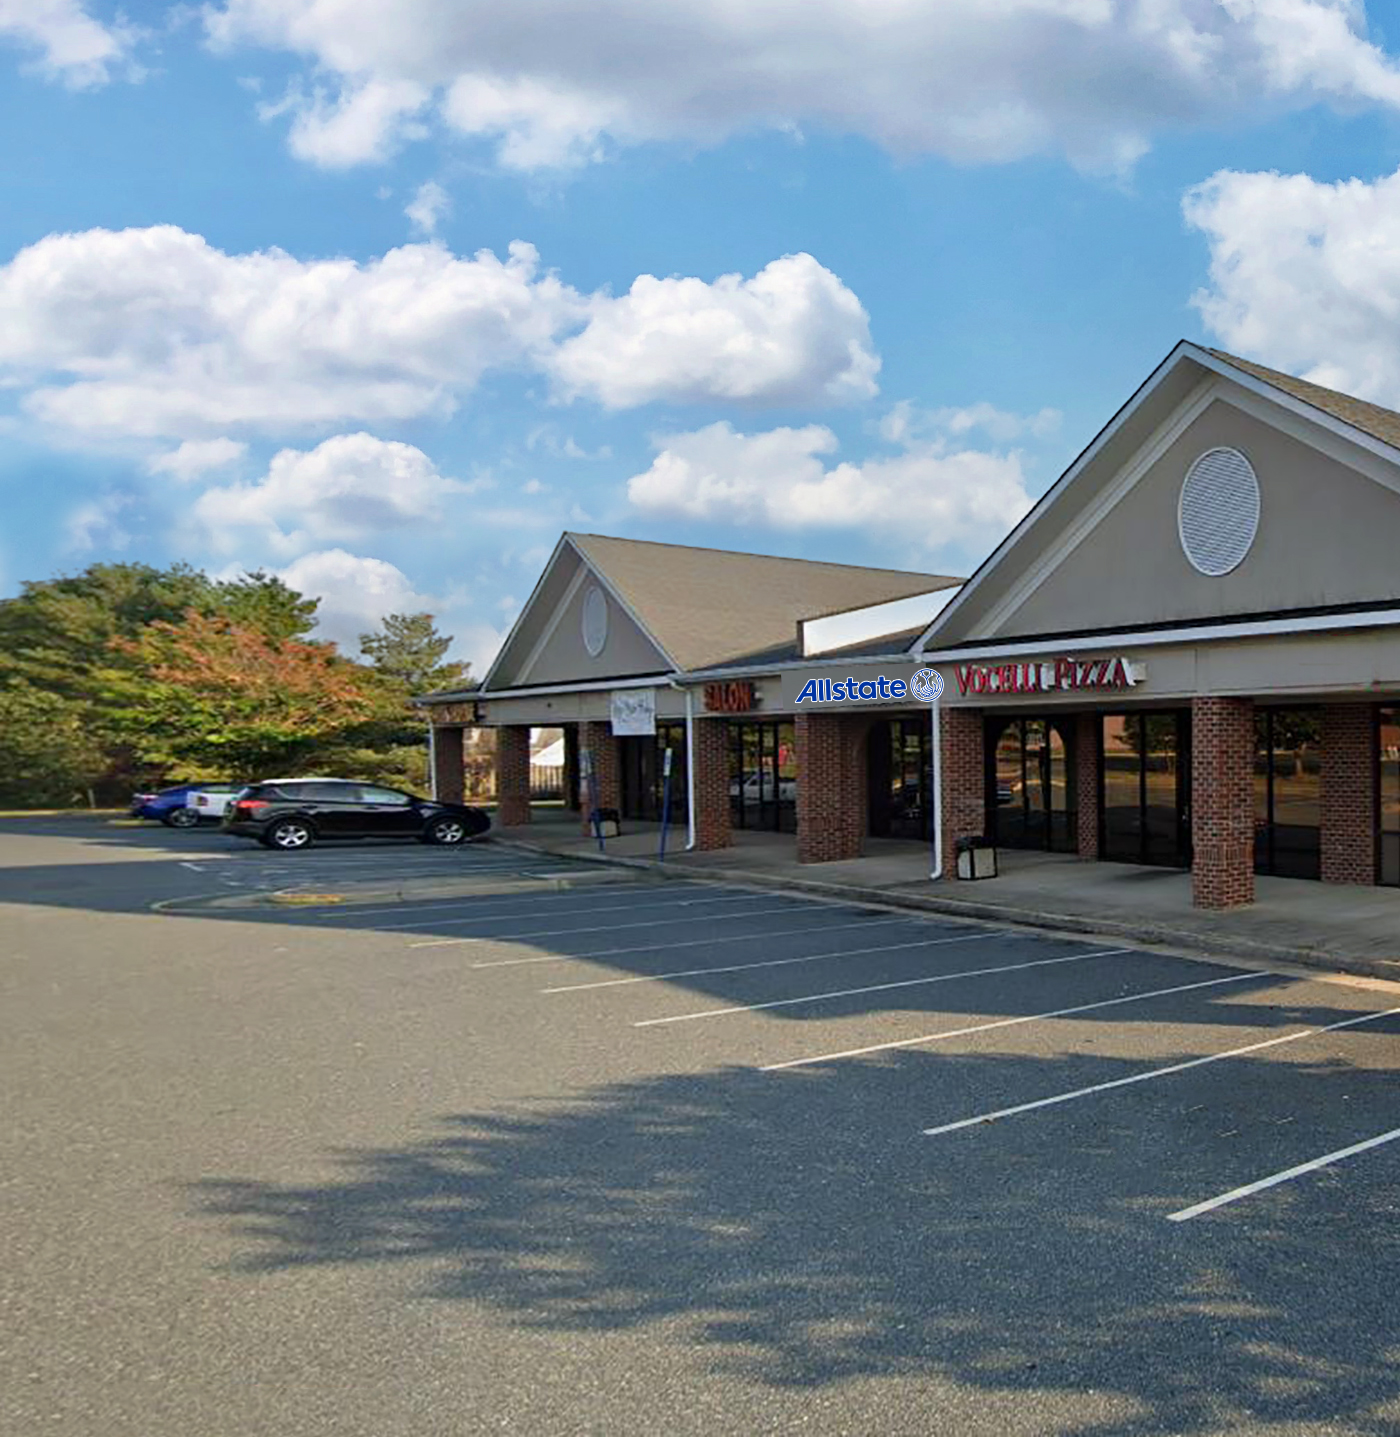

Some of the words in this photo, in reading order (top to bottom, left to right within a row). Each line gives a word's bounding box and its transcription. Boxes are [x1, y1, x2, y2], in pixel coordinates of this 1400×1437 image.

[1054, 657, 1134, 692] PIZZA
[704, 682, 752, 711] SALON
[795, 675, 907, 704] Allstate
